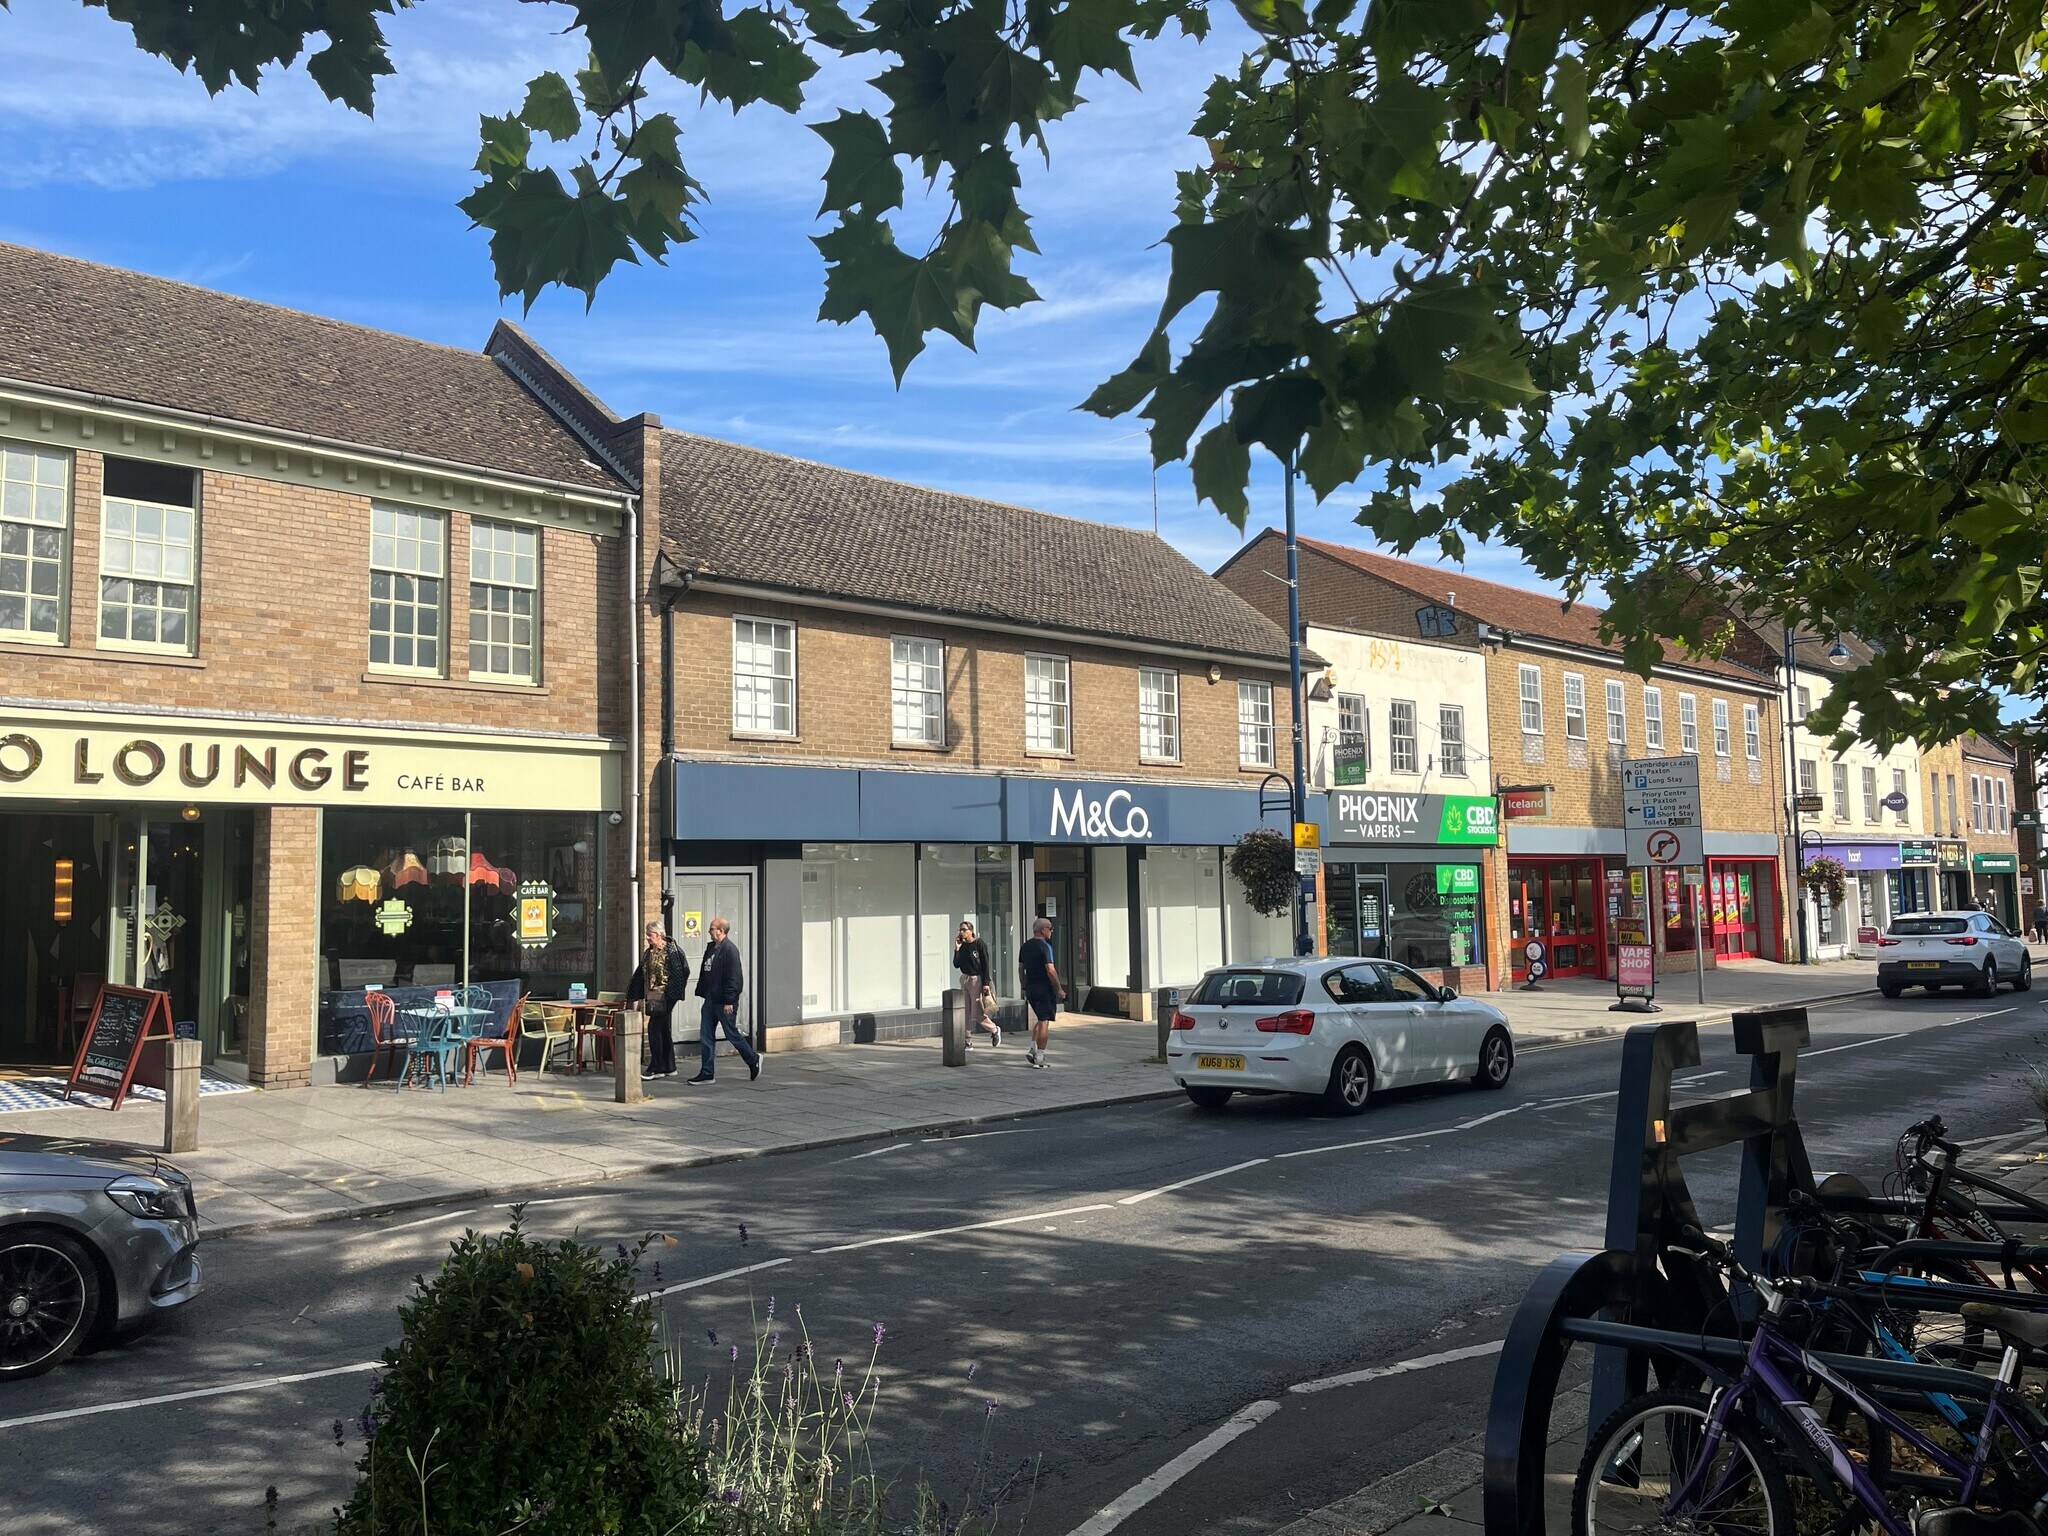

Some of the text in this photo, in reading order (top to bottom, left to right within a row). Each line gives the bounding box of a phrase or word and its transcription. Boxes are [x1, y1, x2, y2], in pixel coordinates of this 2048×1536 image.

[1334, 747, 1364, 757] PHOENIX
[74, 737, 369, 791] LOUNGE
[1634, 761, 1669, 769] Cambridge
[397, 773, 485, 792] CAFÉ BAR
[1338, 794, 1419, 823] PHOENIX
[1508, 799, 1544, 809] Iceland
[1050, 787, 1153, 839] M&Co.
[1465, 805, 1495, 826] CBD
[1359, 824, 1401, 838] VAPERS
[1466, 826, 1496, 835] STOCKISTS
[1847, 849, 1862, 863] haart
[1454, 868, 1475, 881] CBD
[537, 886, 549, 895] BAR
[1621, 932, 1633, 940] MIX
[1620, 947, 1651, 959] VAPE
[1620, 959, 1651, 969] SHOP
[1200, 1056, 1241, 1068] KU68 TSX
[1801, 1419, 1831, 1451] RALEIGH
